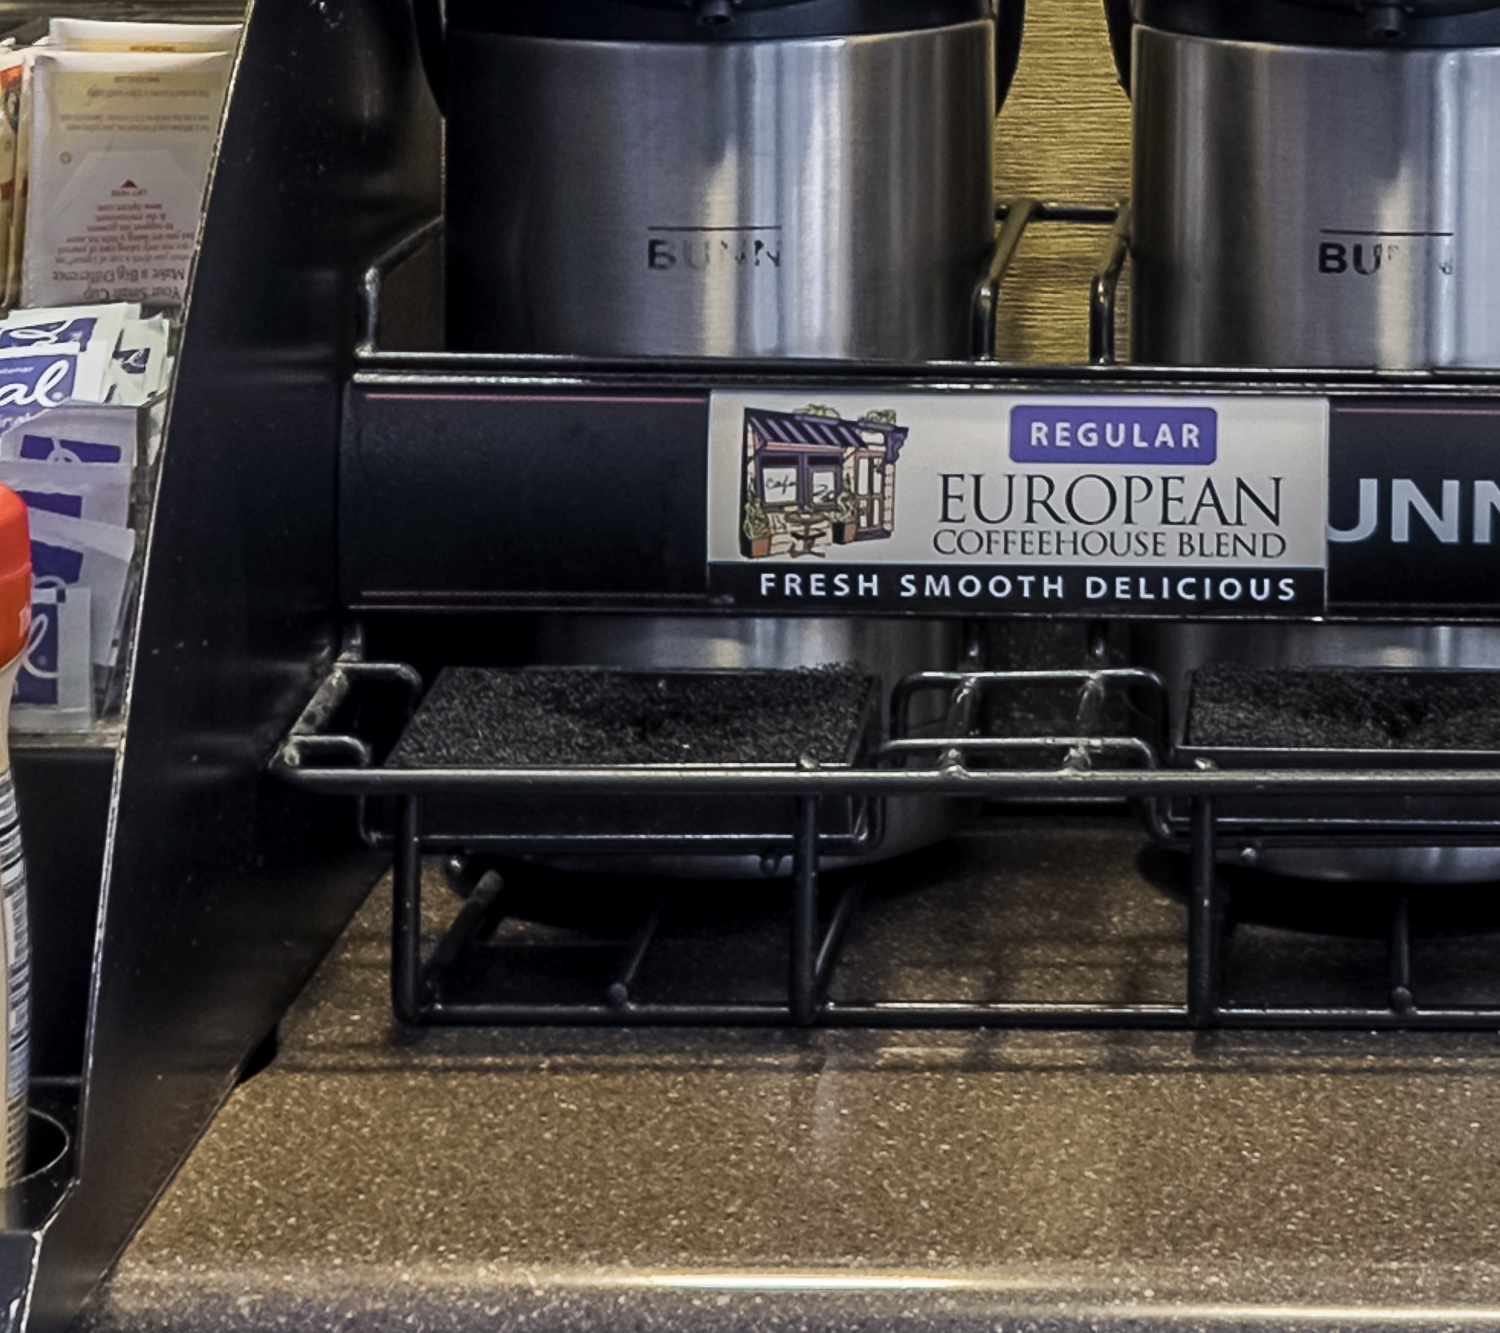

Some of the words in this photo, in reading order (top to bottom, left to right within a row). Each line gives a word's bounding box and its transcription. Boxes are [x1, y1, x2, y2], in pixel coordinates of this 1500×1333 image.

[648, 239, 781, 269] BUN
[1318, 242, 1453, 275] BU
[1029, 421, 1203, 451] REGULAR
[937, 471, 1284, 529] EUROPEAN
[932, 528, 1167, 560] COFFEEHOUSE
[1179, 530, 1289, 560] BLEND
[758, 572, 881, 599] FRESH
[898, 573, 1066, 600] SMOOTH
[1084, 575, 1298, 602] DELICIOUS
